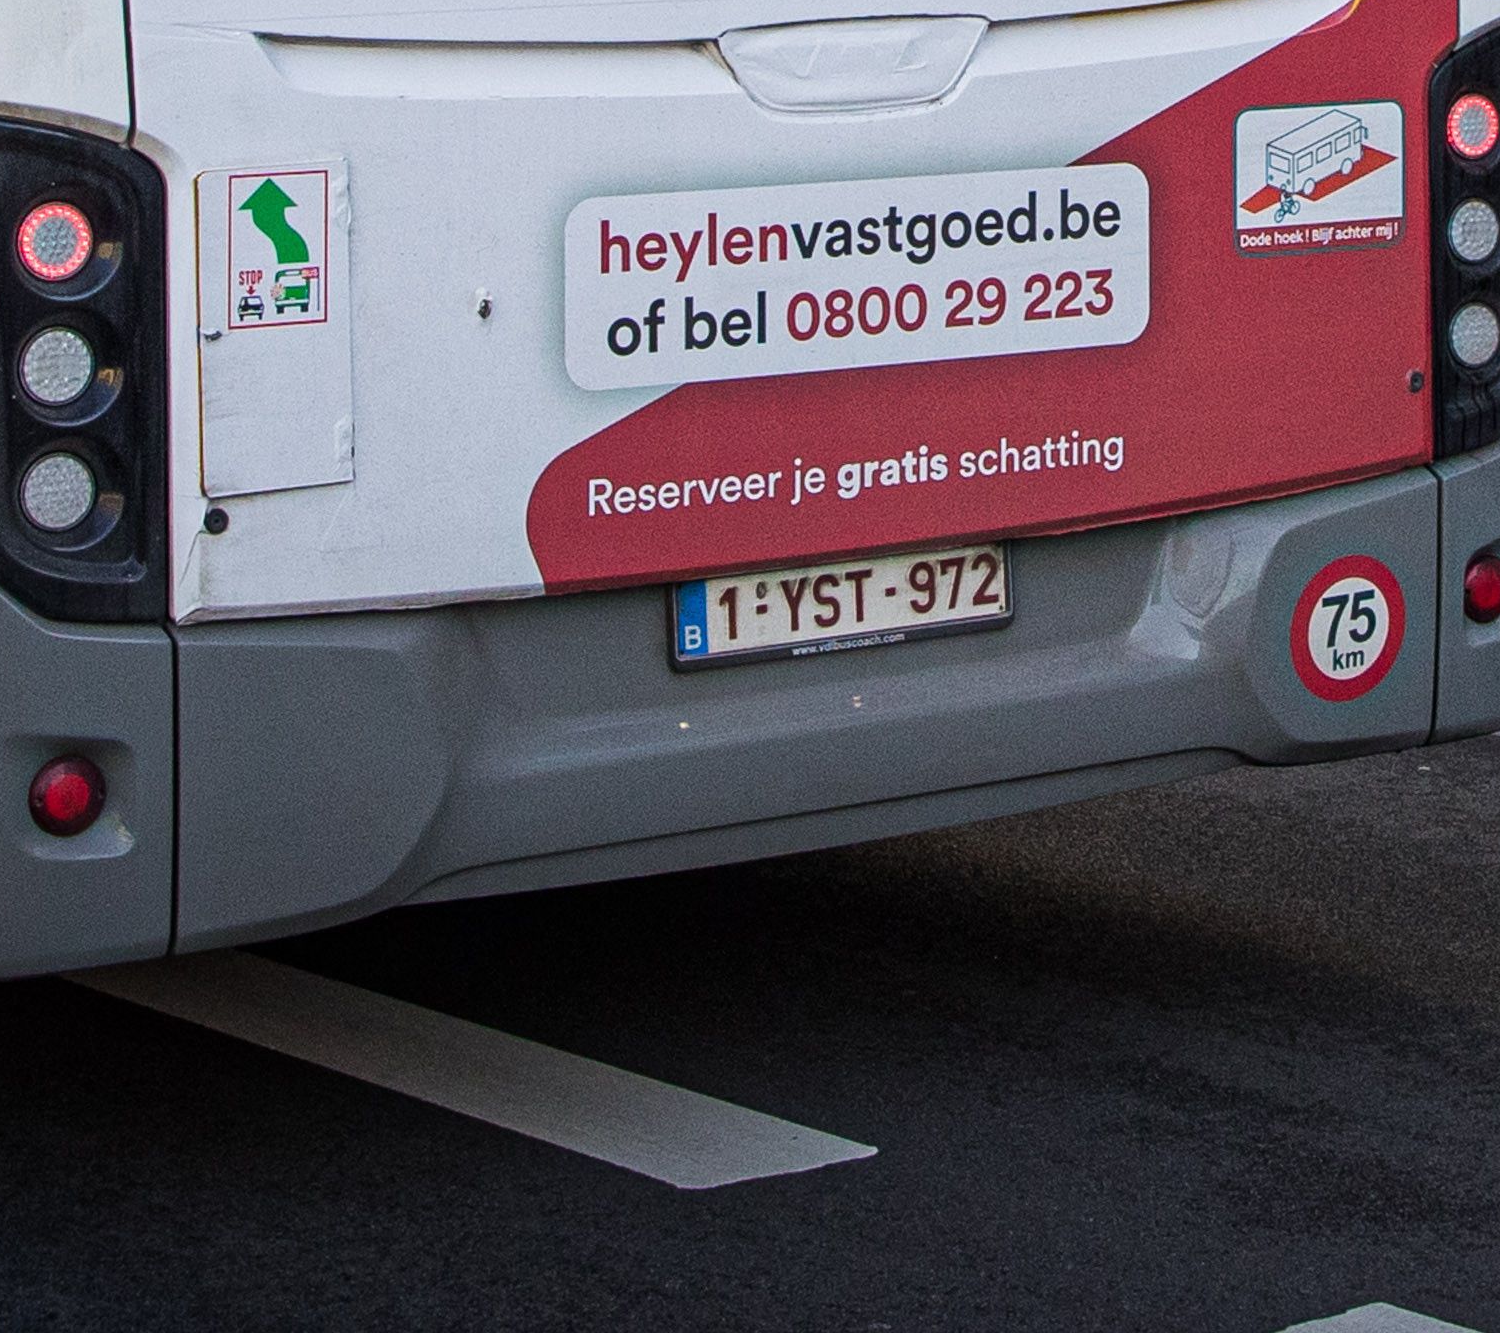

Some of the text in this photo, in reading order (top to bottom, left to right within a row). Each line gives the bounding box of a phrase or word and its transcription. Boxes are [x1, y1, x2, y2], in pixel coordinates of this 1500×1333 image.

[599, 188, 1122, 283] heylenvastgoed.be
[1240, 229, 1272, 248] Dode
[1274, 230, 1303, 245] hoek
[1312, 227, 1334, 245] Blijf
[1336, 224, 1373, 239] achter
[1375, 223, 1393, 241] mij
[238, 269, 263, 286] STOP
[607, 268, 1114, 357] of bel 0800 29 223
[587, 430, 1125, 517] Reserveer je gratis schatting
[684, 624, 702, 650] B
[1322, 589, 1377, 648] 75
[1332, 649, 1365, 672] km
